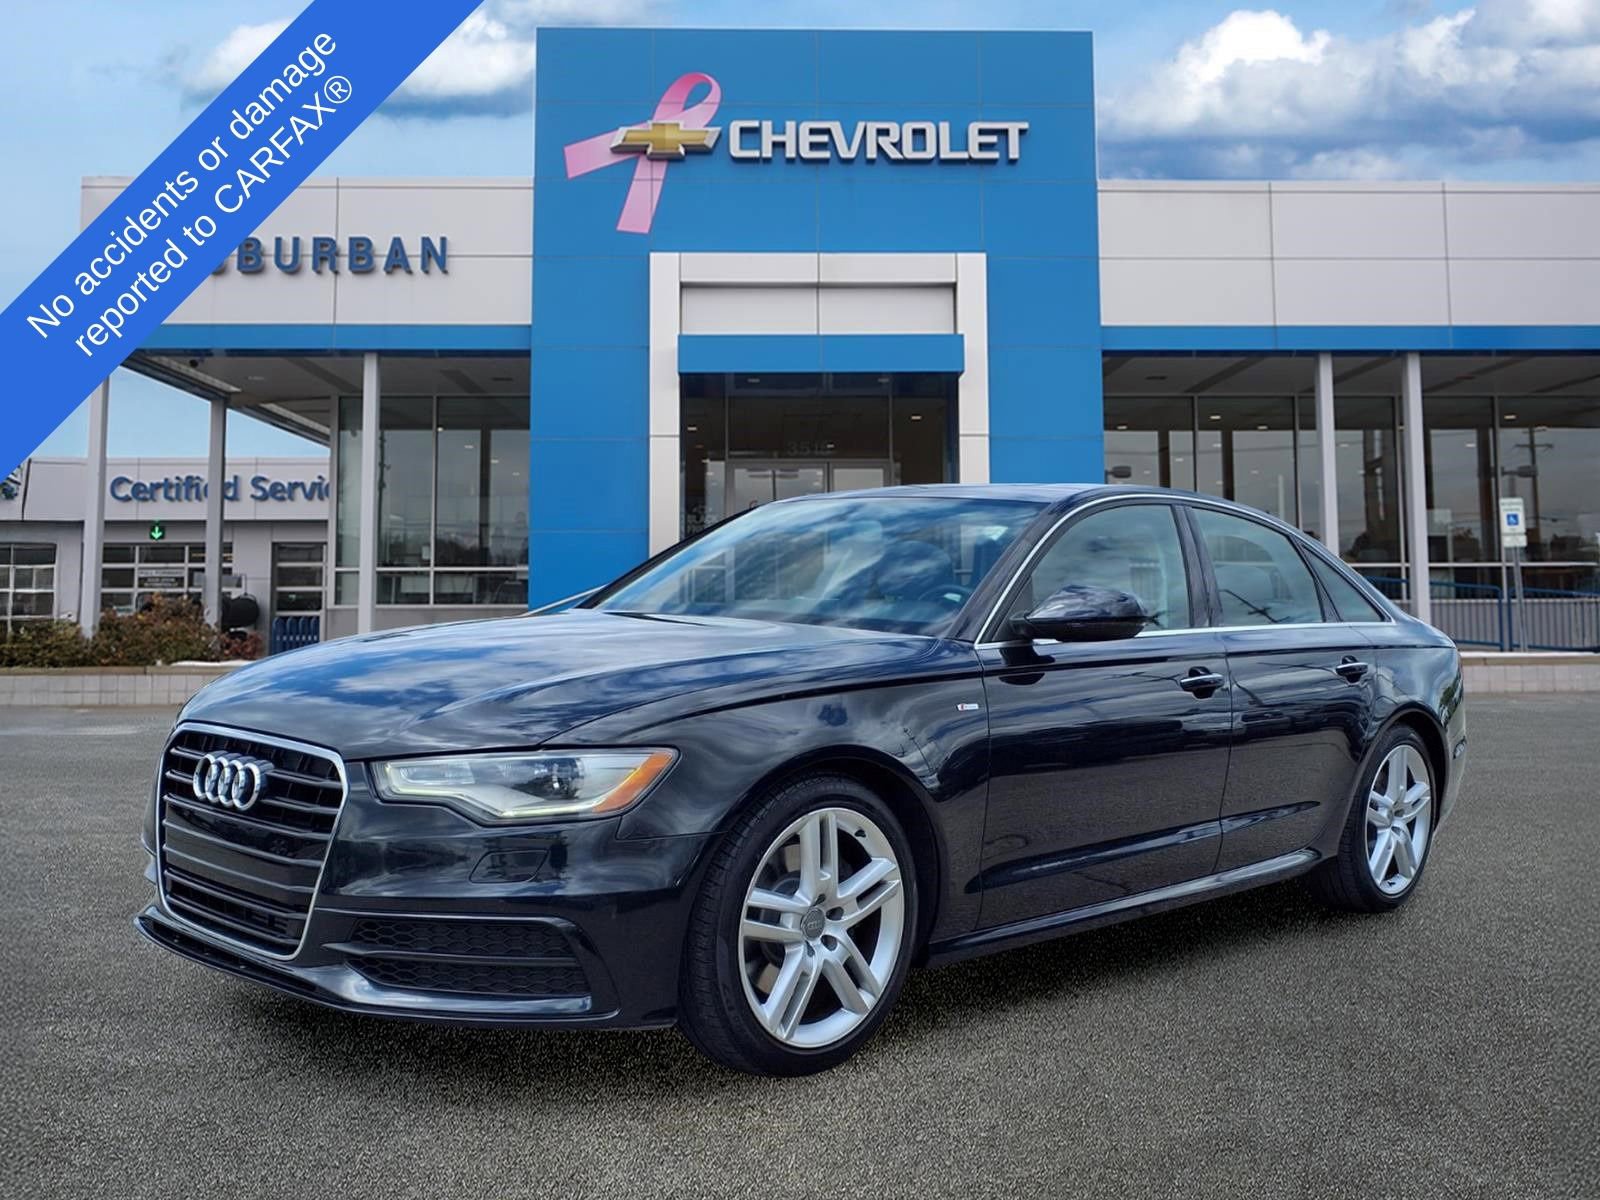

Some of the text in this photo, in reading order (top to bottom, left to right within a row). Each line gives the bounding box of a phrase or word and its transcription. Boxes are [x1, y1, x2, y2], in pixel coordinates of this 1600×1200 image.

[729, 119, 1029, 161] CHEVROLET
[211, 236, 449, 275] BURBAN
[109, 474, 330, 502] Certifid Servi
